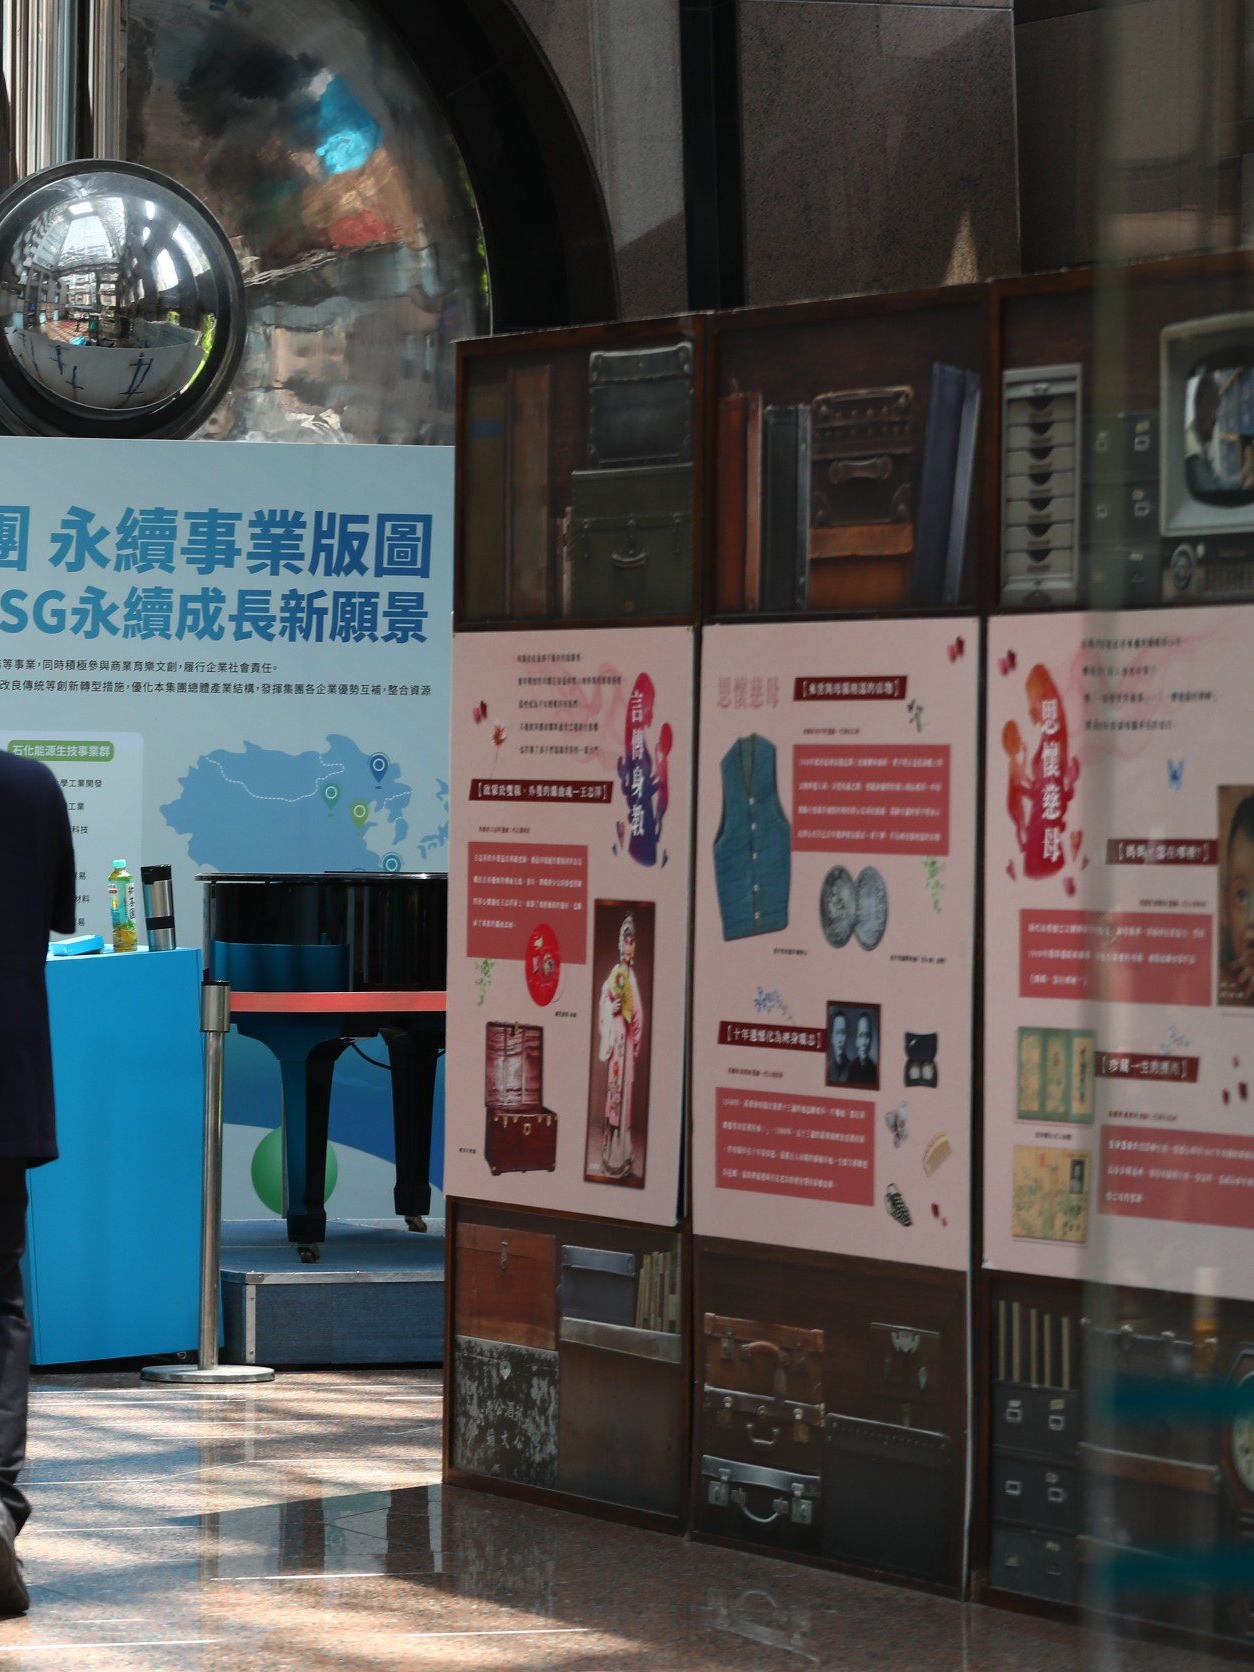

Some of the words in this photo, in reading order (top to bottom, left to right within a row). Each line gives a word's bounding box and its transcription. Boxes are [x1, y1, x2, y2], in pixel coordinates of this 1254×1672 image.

[48, 506, 433, 579] 永續事業版圖
[12, 744, 110, 757] 石化能源生技事業群
[59, 779, 102, 788] 學工業開發
